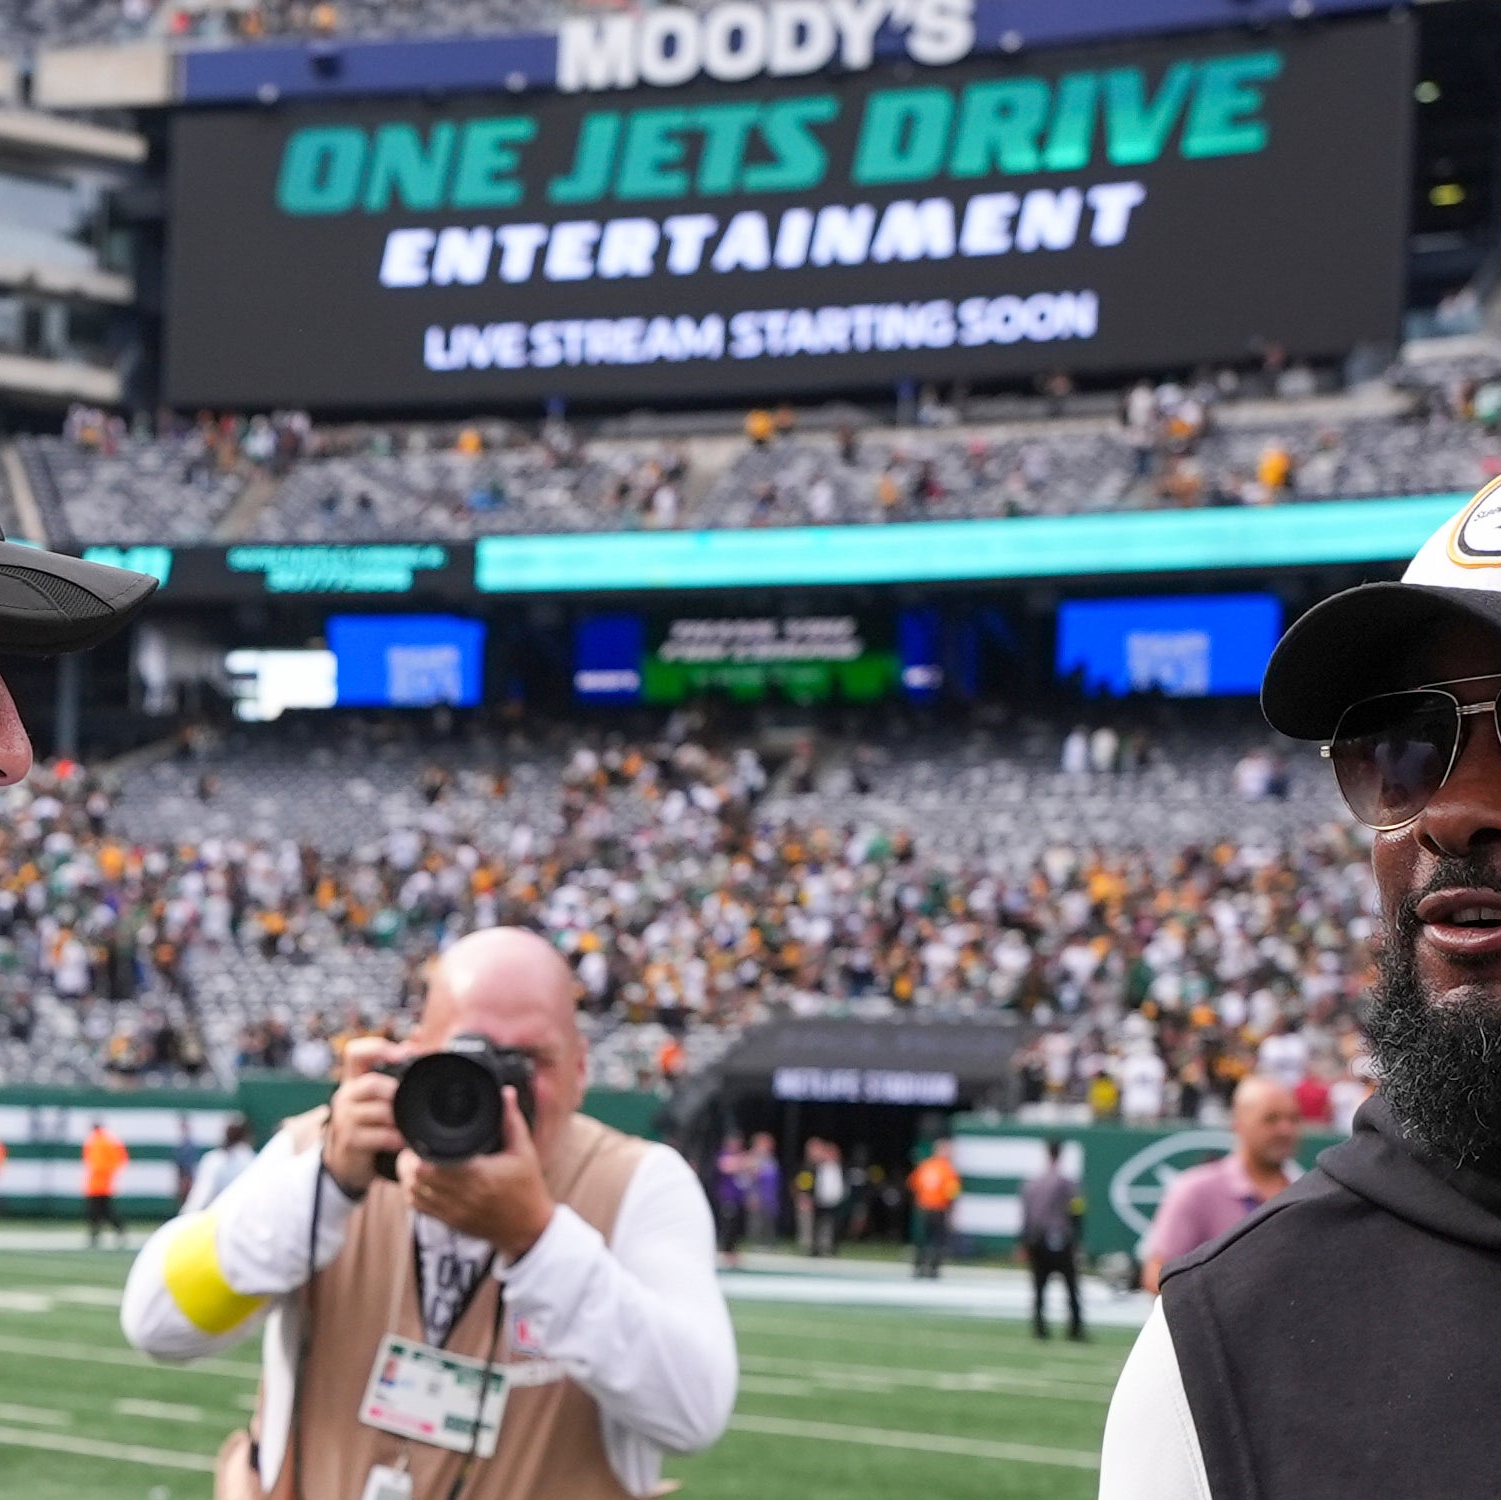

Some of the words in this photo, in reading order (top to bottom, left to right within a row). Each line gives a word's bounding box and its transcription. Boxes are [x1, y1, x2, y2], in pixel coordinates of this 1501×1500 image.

[555, 0, 977, 93] MOODY'S
[276, 115, 540, 214] ONE
[548, 94, 840, 205] JETS
[850, 48, 1284, 187] DRIVE
[379, 179, 1146, 287] ENTERTAINMENT
[728, 299, 957, 359] STARTING
[956, 289, 1098, 347] SOON
